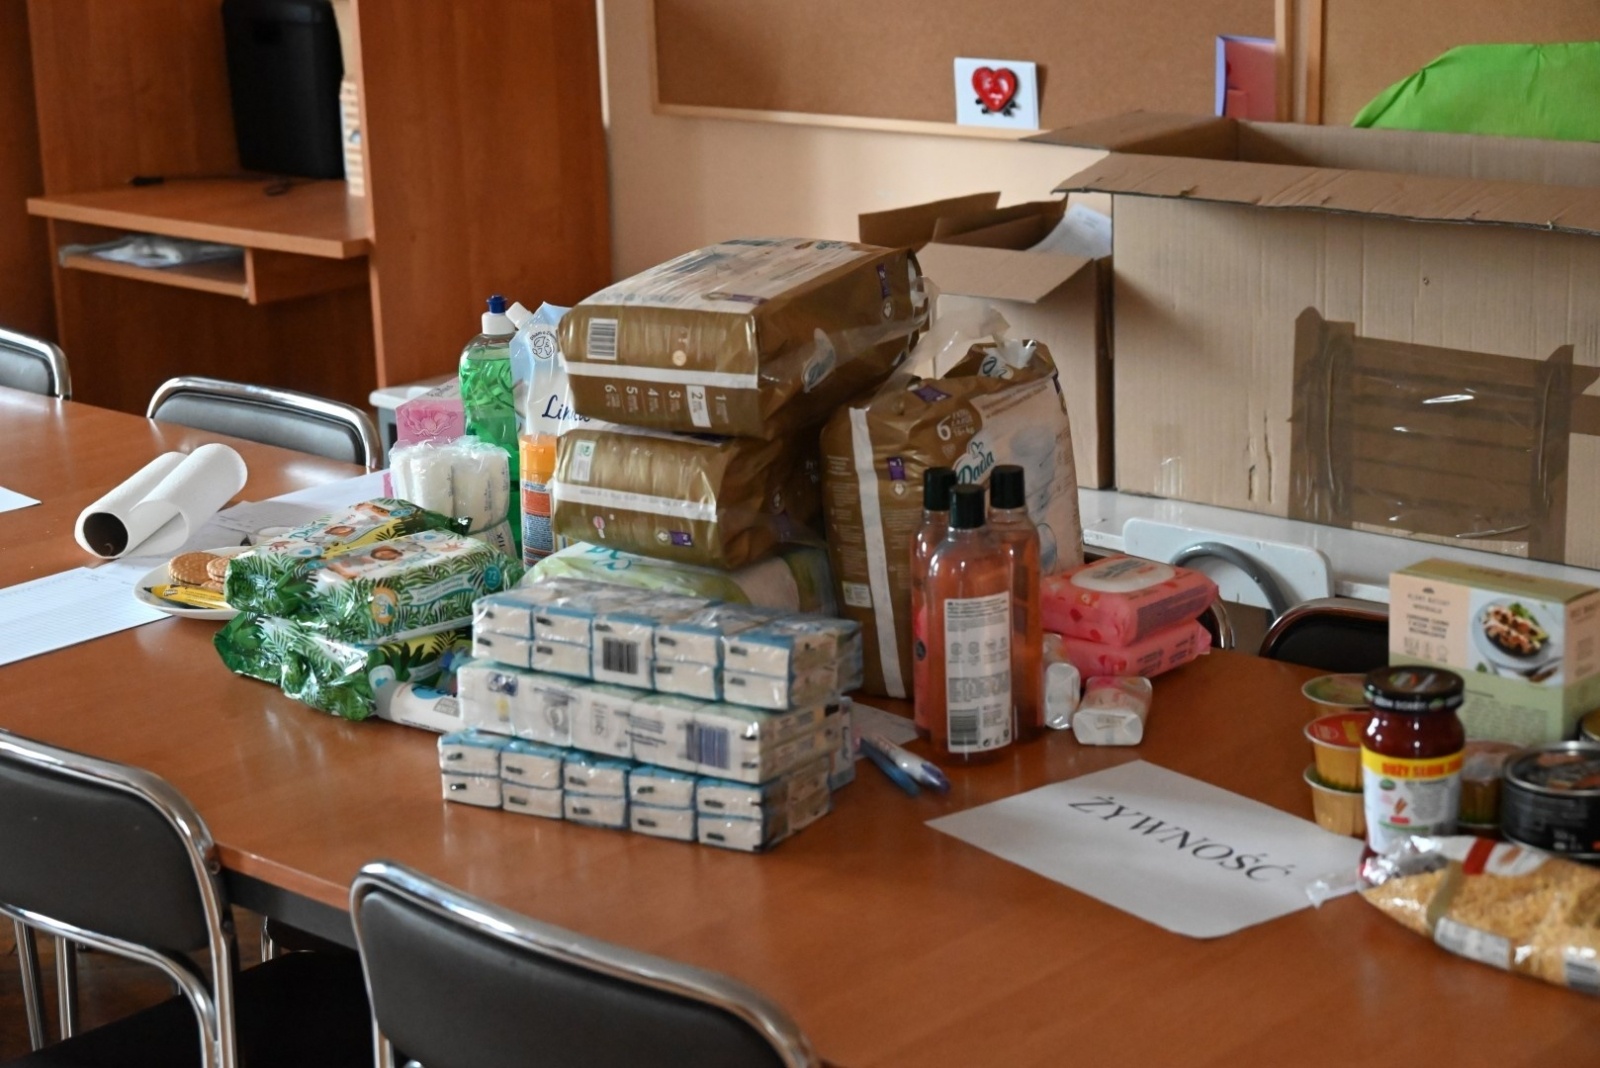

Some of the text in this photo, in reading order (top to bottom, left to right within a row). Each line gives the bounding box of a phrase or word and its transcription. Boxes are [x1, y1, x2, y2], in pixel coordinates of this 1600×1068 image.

[604, 384, 617, 393] 6
[626, 386, 639, 394] 5
[647, 388, 659, 397] 4
[668, 390, 681, 398] 3
[691, 391, 704, 400] 2
[936, 414, 952, 441] 6
[957, 451, 994, 484] Dada
[1068, 794, 1295, 882] ŻYWNOŚĆ
